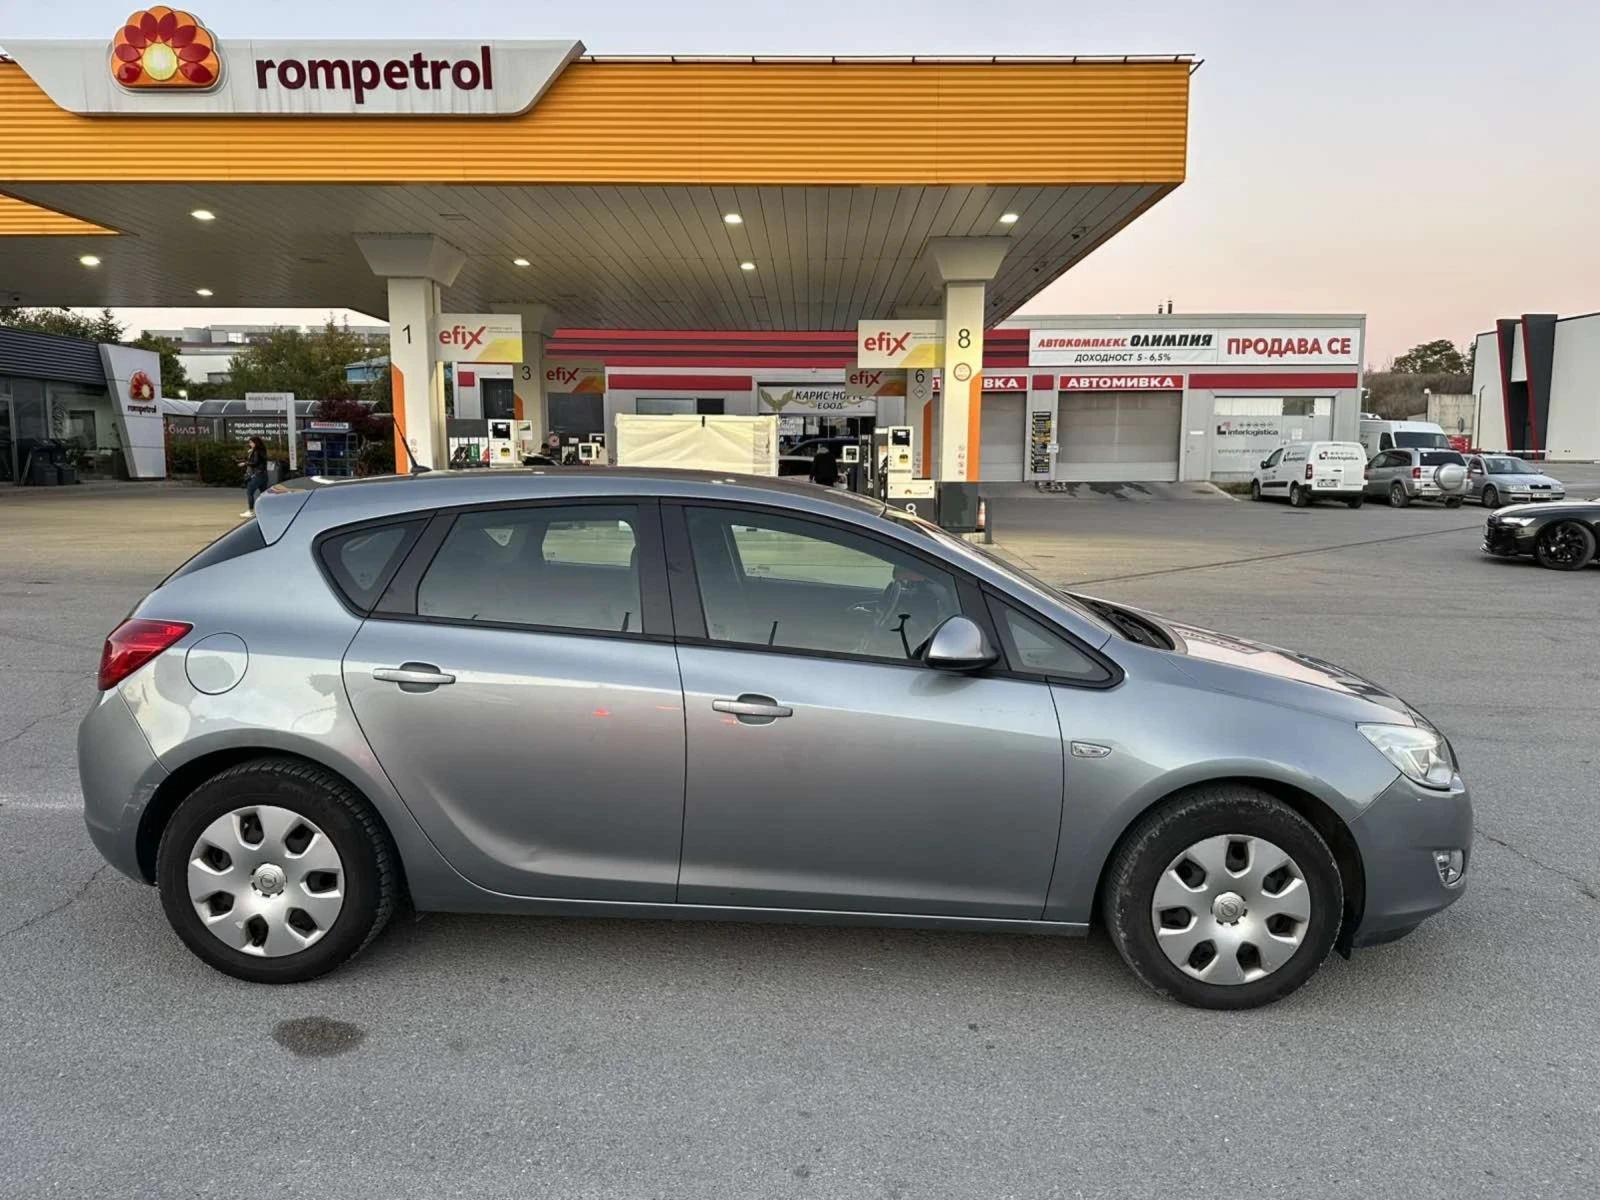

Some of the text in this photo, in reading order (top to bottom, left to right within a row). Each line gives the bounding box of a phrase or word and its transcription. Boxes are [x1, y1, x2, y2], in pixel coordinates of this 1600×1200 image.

[255, 45, 493, 105] rompetrol
[402, 324, 412, 345] 1
[438, 325, 487, 351] efix
[957, 328, 972, 349] 8
[1038, 334, 1213, 348] АВТОКОМПЛЕКС ОЛИМПИЯ
[863, 331, 912, 357] efix
[1226, 337, 1352, 358] ПРОДАВА СЕ
[1074, 353, 1134, 363] ДОХОДНОСТ
[1136, 353, 1143, 362] 5
[1149, 353, 1172, 363] 6,5%
[521, 365, 532, 381] 3
[546, 367, 580, 385] efix
[849, 370, 883, 388] efix
[914, 369, 926, 383] 6
[1066, 377, 1175, 388] АВТОМИВКА
[795, 391, 831, 401] КАРИС
[817, 402, 843, 410] ЕООД
